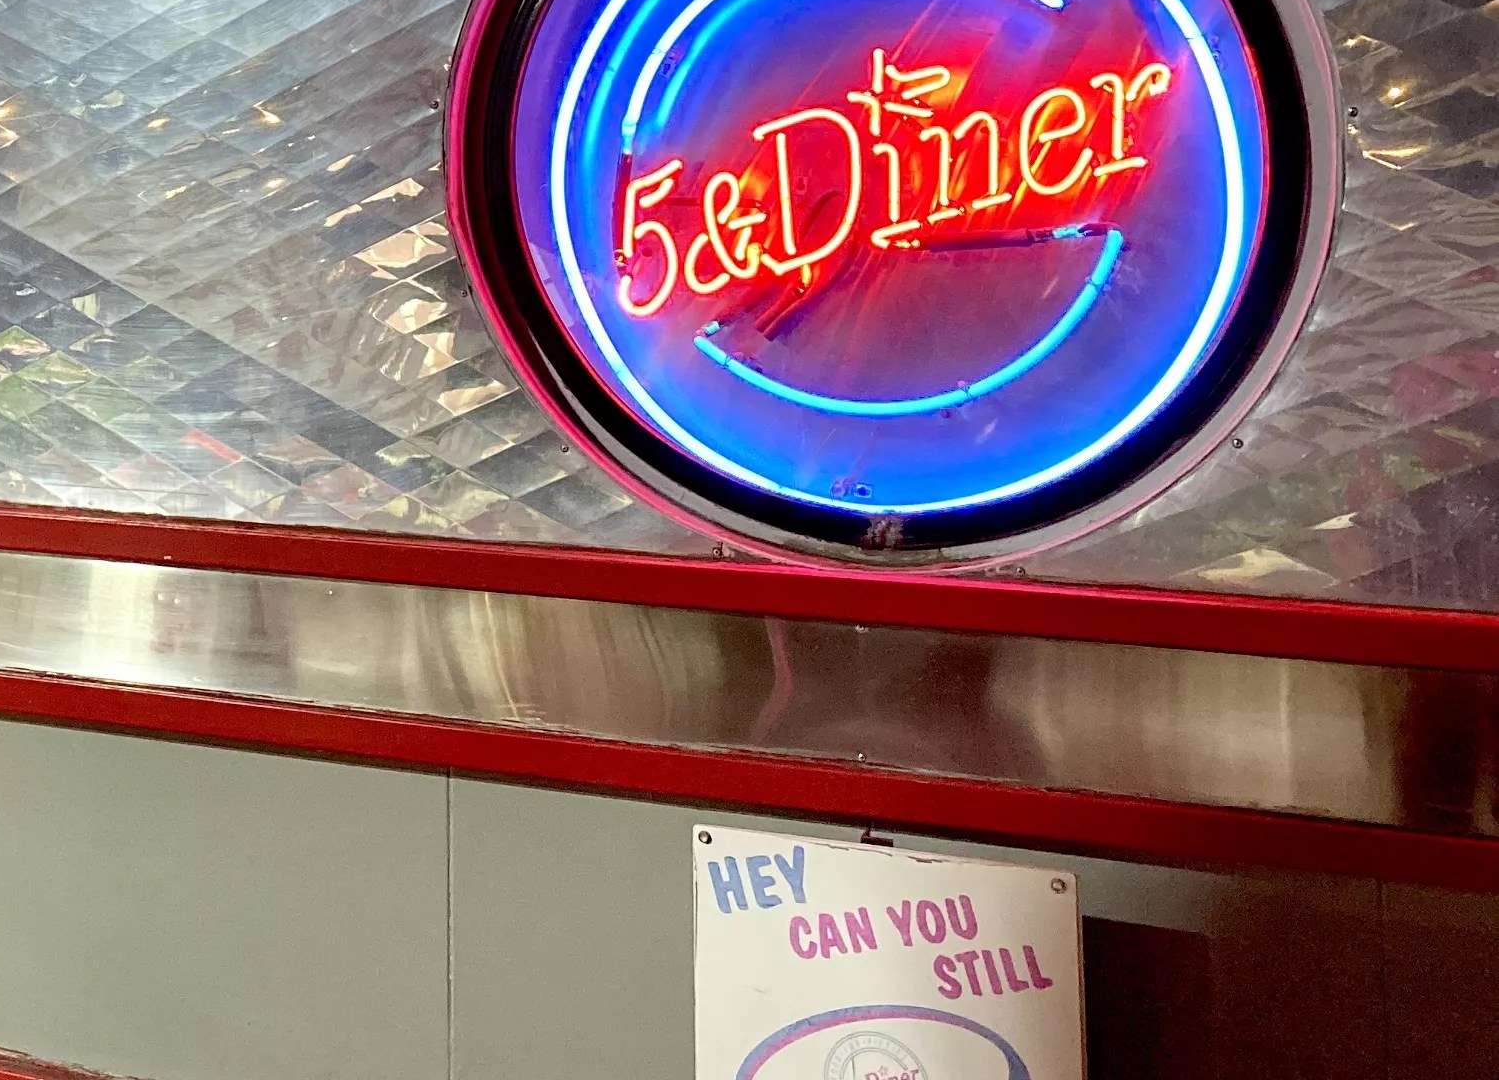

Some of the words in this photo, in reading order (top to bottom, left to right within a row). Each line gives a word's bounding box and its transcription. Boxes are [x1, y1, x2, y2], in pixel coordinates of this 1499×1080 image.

[707, 845, 808, 914] HEY
[789, 906, 878, 960] CAN
[886, 894, 979, 947] YOU
[932, 944, 1054, 1000] STILL
